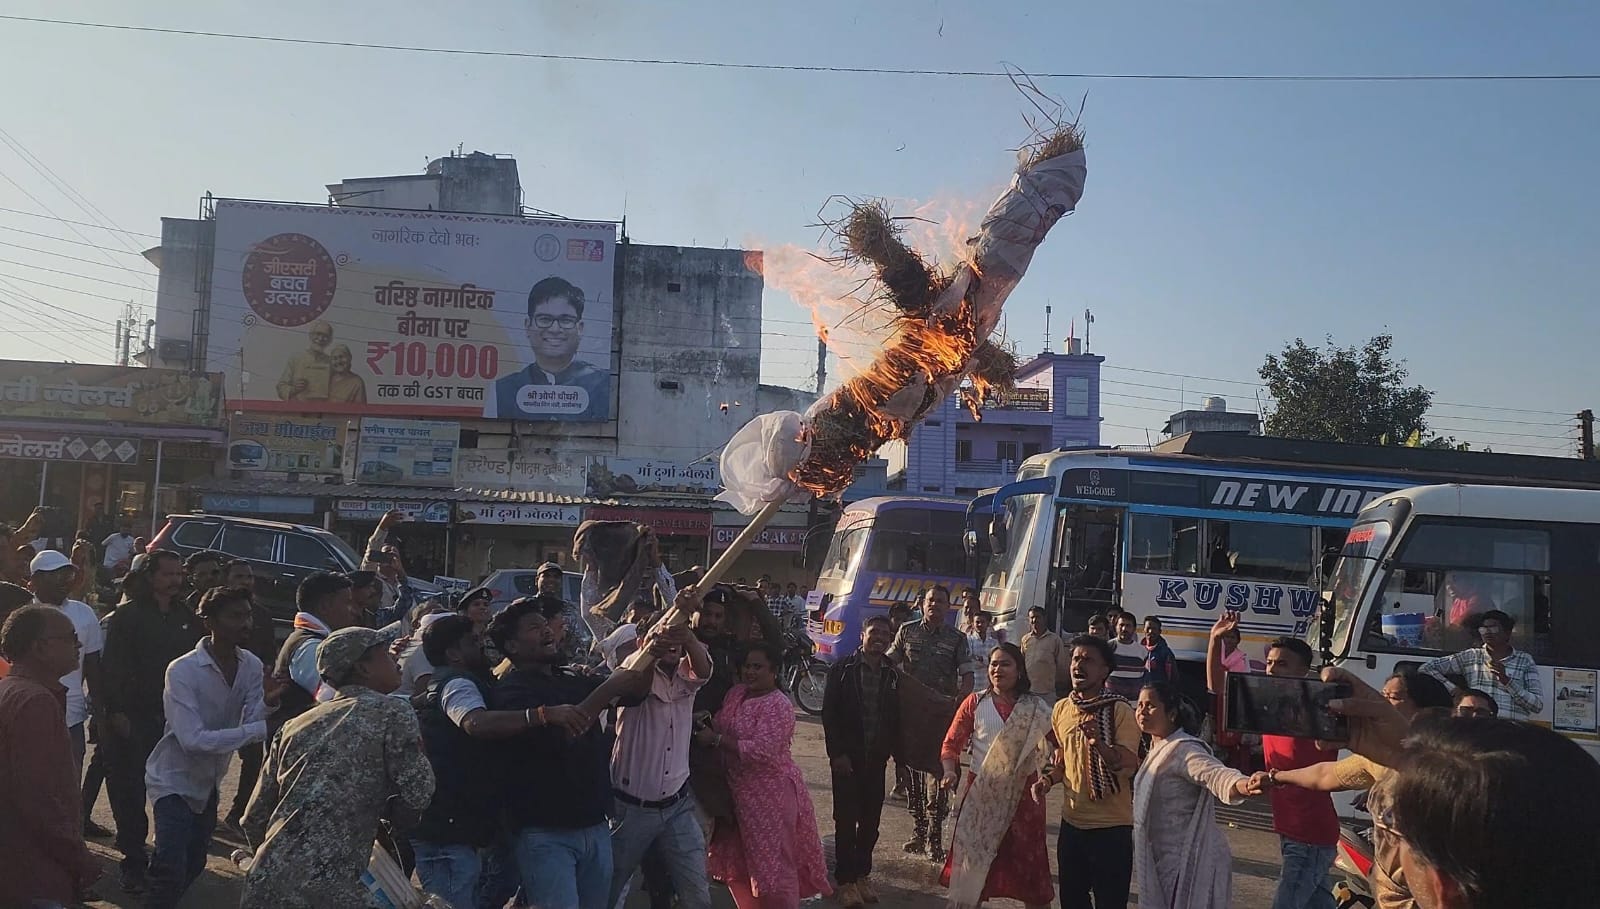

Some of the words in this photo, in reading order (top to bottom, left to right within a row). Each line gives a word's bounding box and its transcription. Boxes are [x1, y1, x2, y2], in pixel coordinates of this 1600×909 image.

[371, 226, 425, 244] नागरिक
[428, 227, 453, 245] देवो
[261, 256, 319, 276] जीएसटी
[269, 275, 309, 291] बचत
[263, 290, 313, 306] उत्सव
[374, 280, 420, 307] वरिष्ठ
[422, 283, 495, 310] नागरिक
[397, 310, 441, 337] बीमा
[443, 318, 470, 338] पर
[367, 341, 498, 379] ₹10,000
[377, 384, 400, 398] तक
[403, 380, 420, 398] की
[424, 385, 453, 399] GST
[457, 386, 485, 400] बचत
[654, 466, 676, 482] दुर्गा
[679, 466, 716, 481] ज्वेलर्स
[1076, 485, 1116, 497] WELCOME
[1211, 480, 1310, 511] NEW
[498, 506, 521, 523] दुर्गा
[524, 508, 564, 521] ज्वेलर्स
